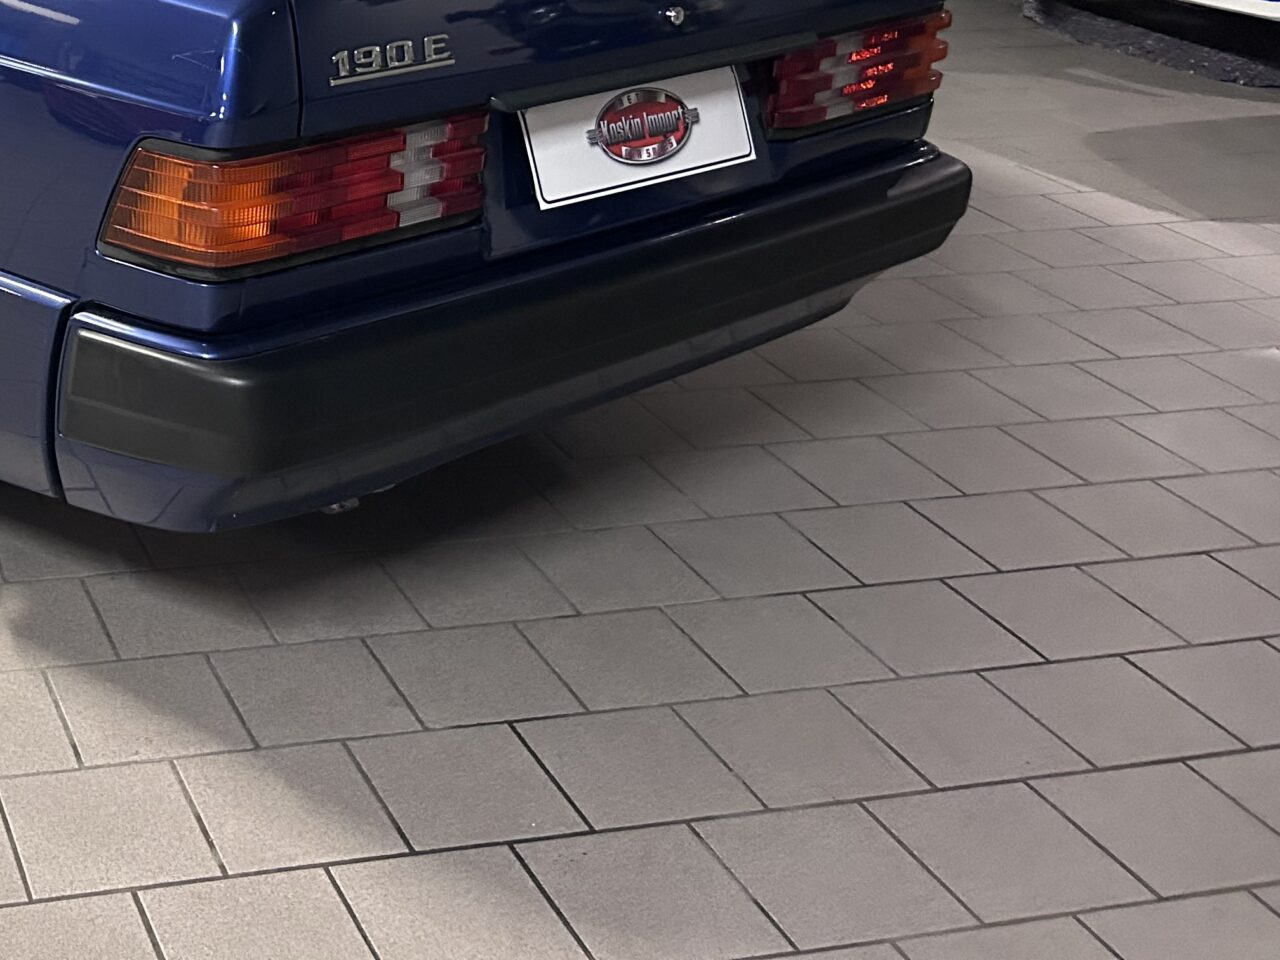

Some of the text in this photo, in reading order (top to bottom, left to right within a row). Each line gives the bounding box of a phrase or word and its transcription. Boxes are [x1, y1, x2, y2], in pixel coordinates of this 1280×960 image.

[332, 34, 451, 76] 190 E
[600, 105, 684, 145] Koskin Import
